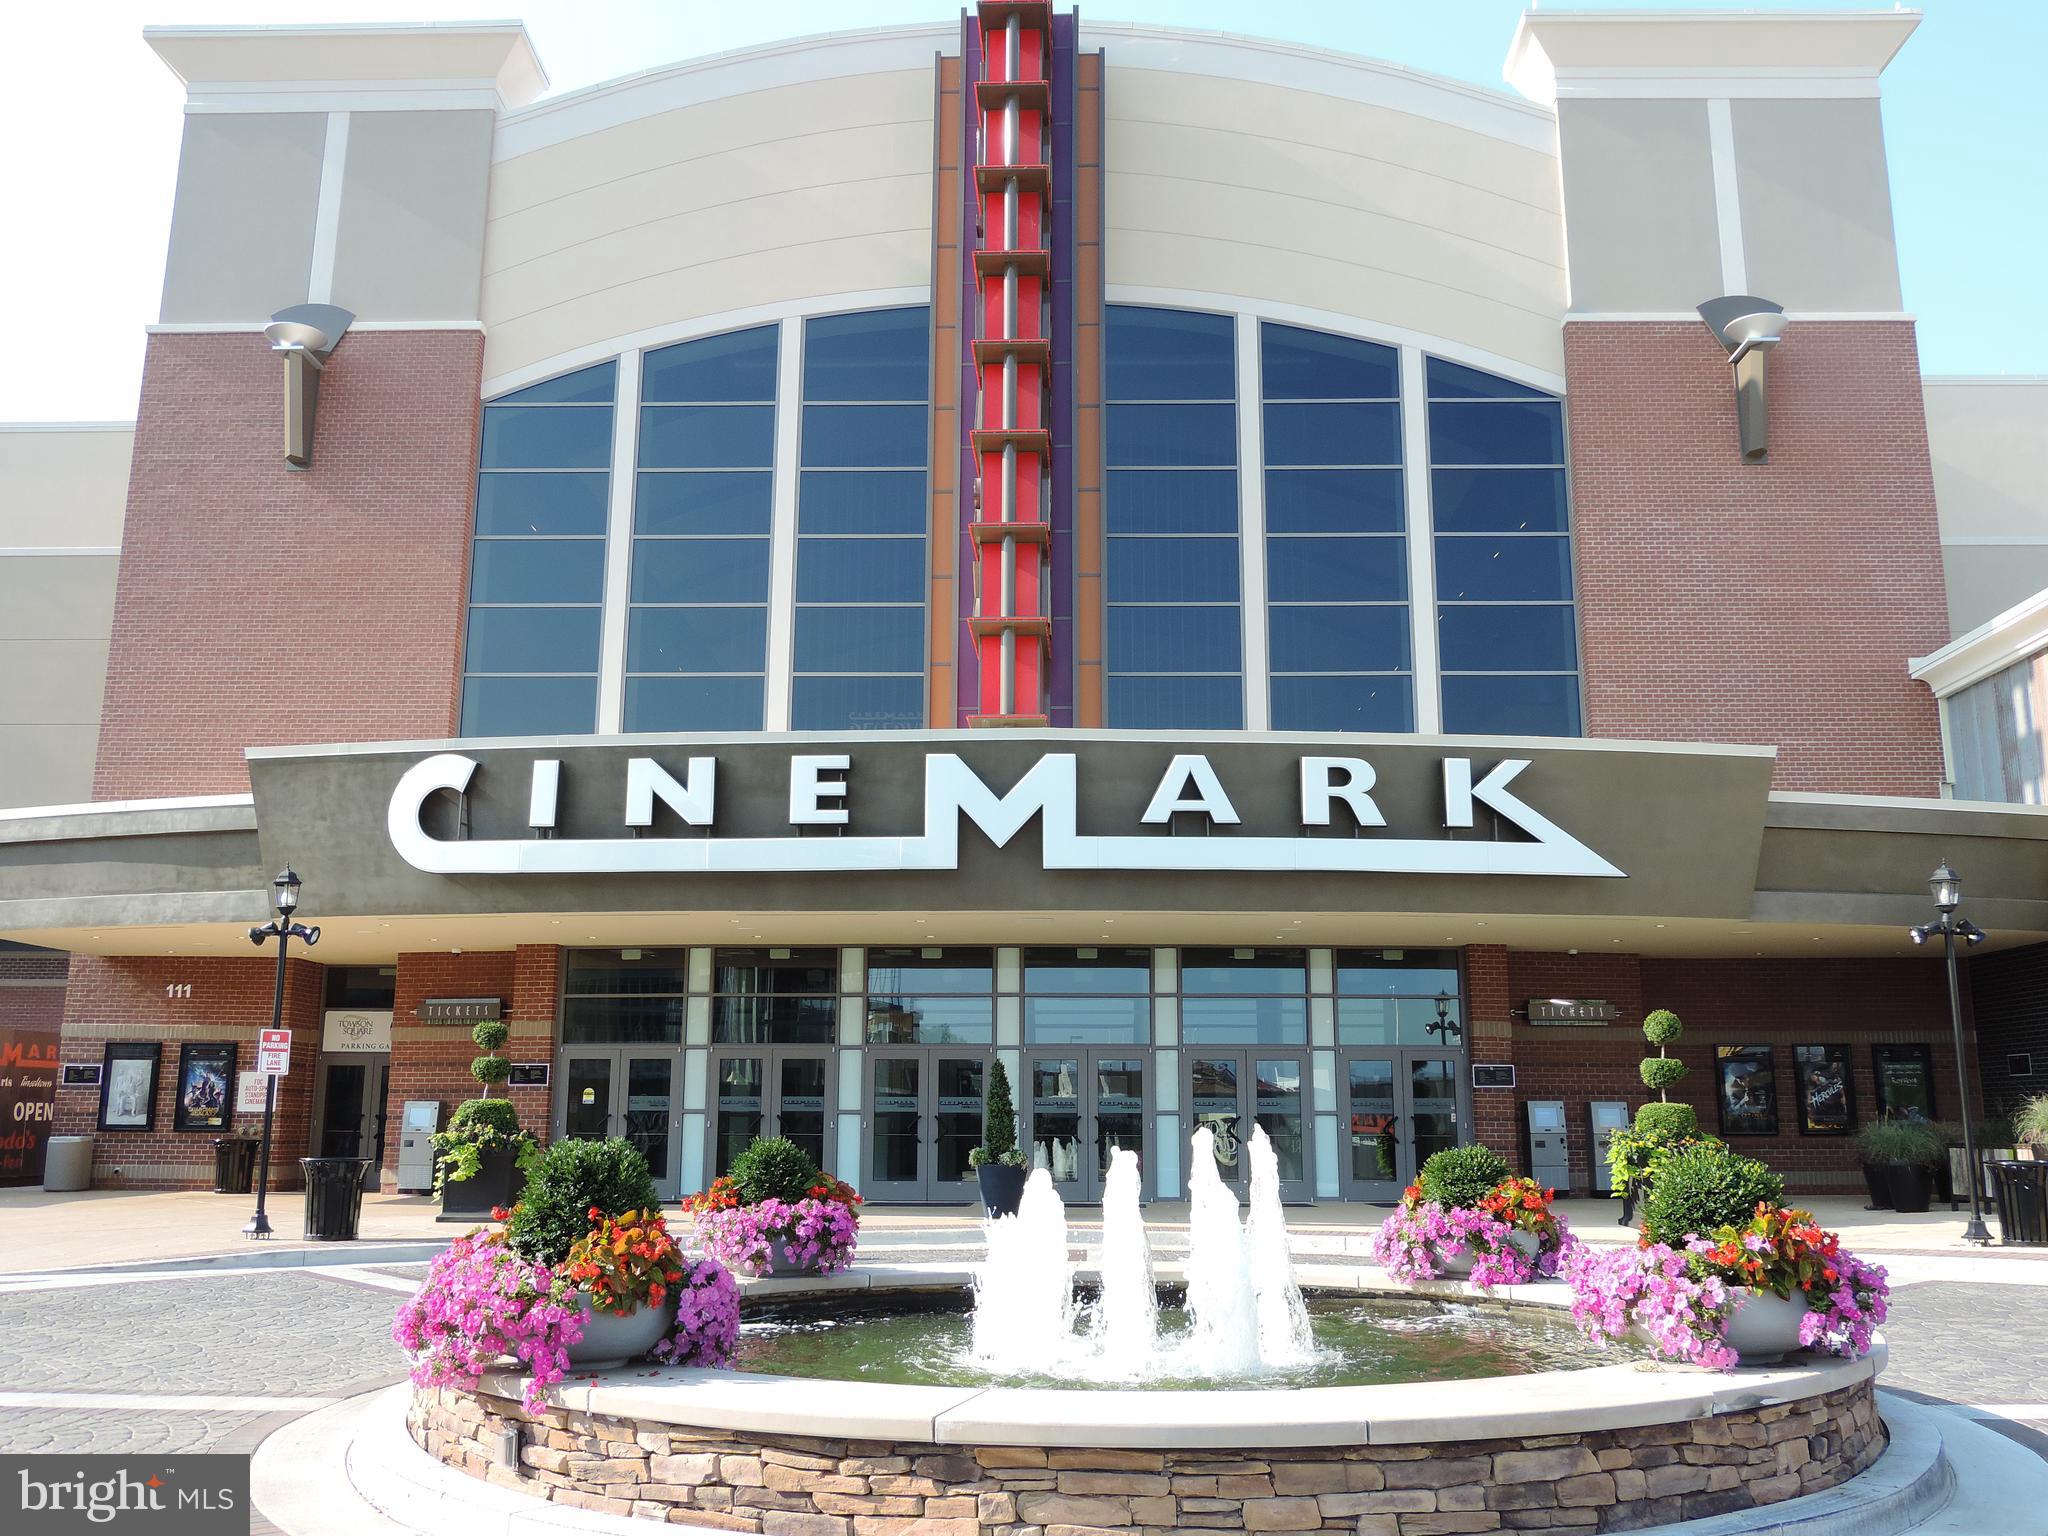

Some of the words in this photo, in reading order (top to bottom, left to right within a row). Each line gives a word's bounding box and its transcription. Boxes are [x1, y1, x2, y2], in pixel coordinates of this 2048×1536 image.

[388, 752, 1628, 877] CINEMARK
[166, 983, 192, 998] 111
[428, 1005, 489, 1016] TICKETS
[1541, 1006, 1604, 1017] TICKETS
[337, 1019, 374, 1028] TOWSON
[343, 1027, 374, 1036] SQUARE
[271, 1034, 281, 1042] NO
[1810, 1080, 1843, 1109] HERCULES
